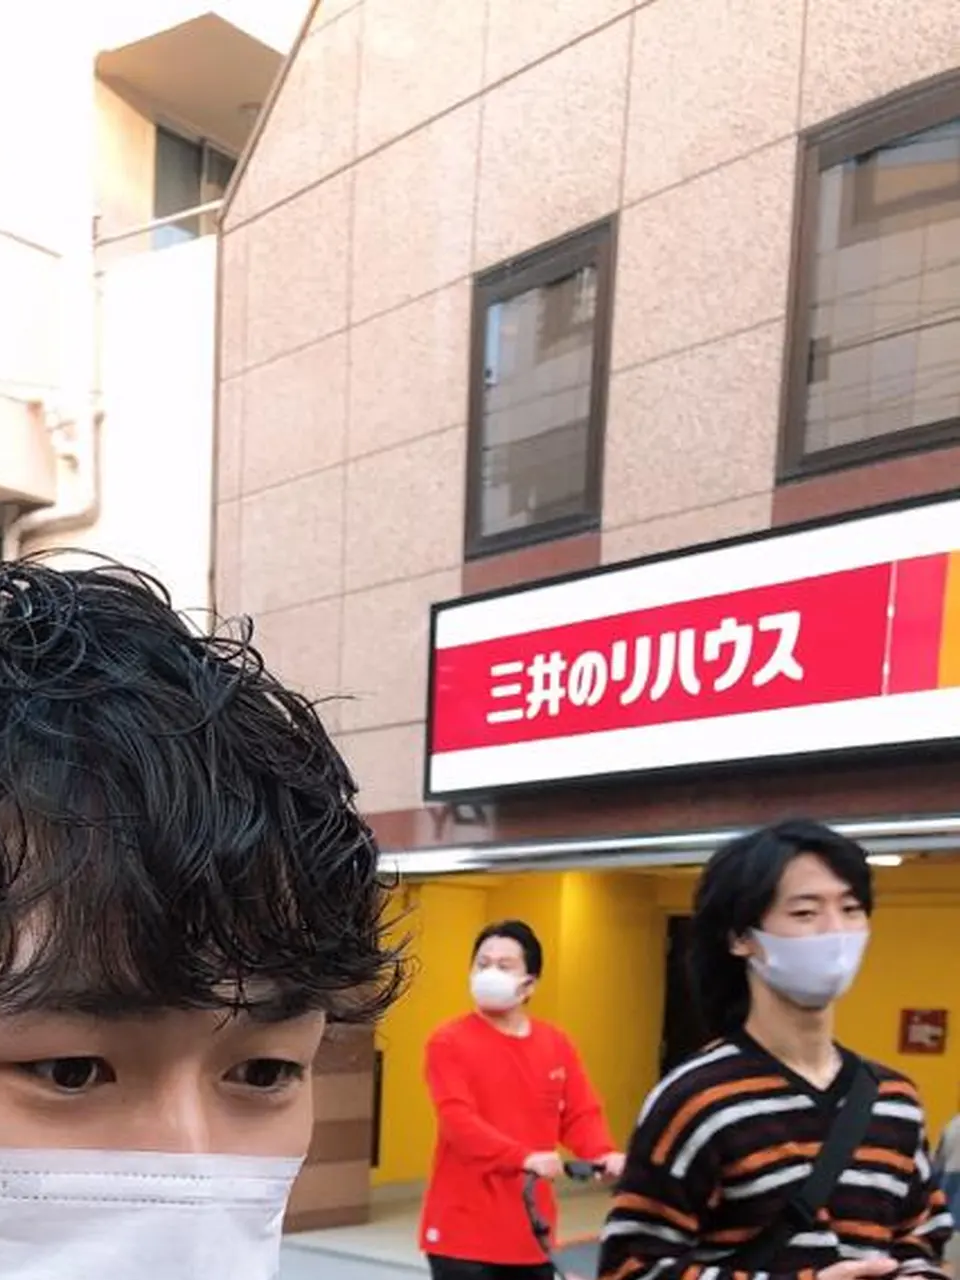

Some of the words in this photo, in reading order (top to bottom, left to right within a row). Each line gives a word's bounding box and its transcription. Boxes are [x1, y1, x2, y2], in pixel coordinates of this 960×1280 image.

[486, 610, 804, 725] 三井のリハウス
